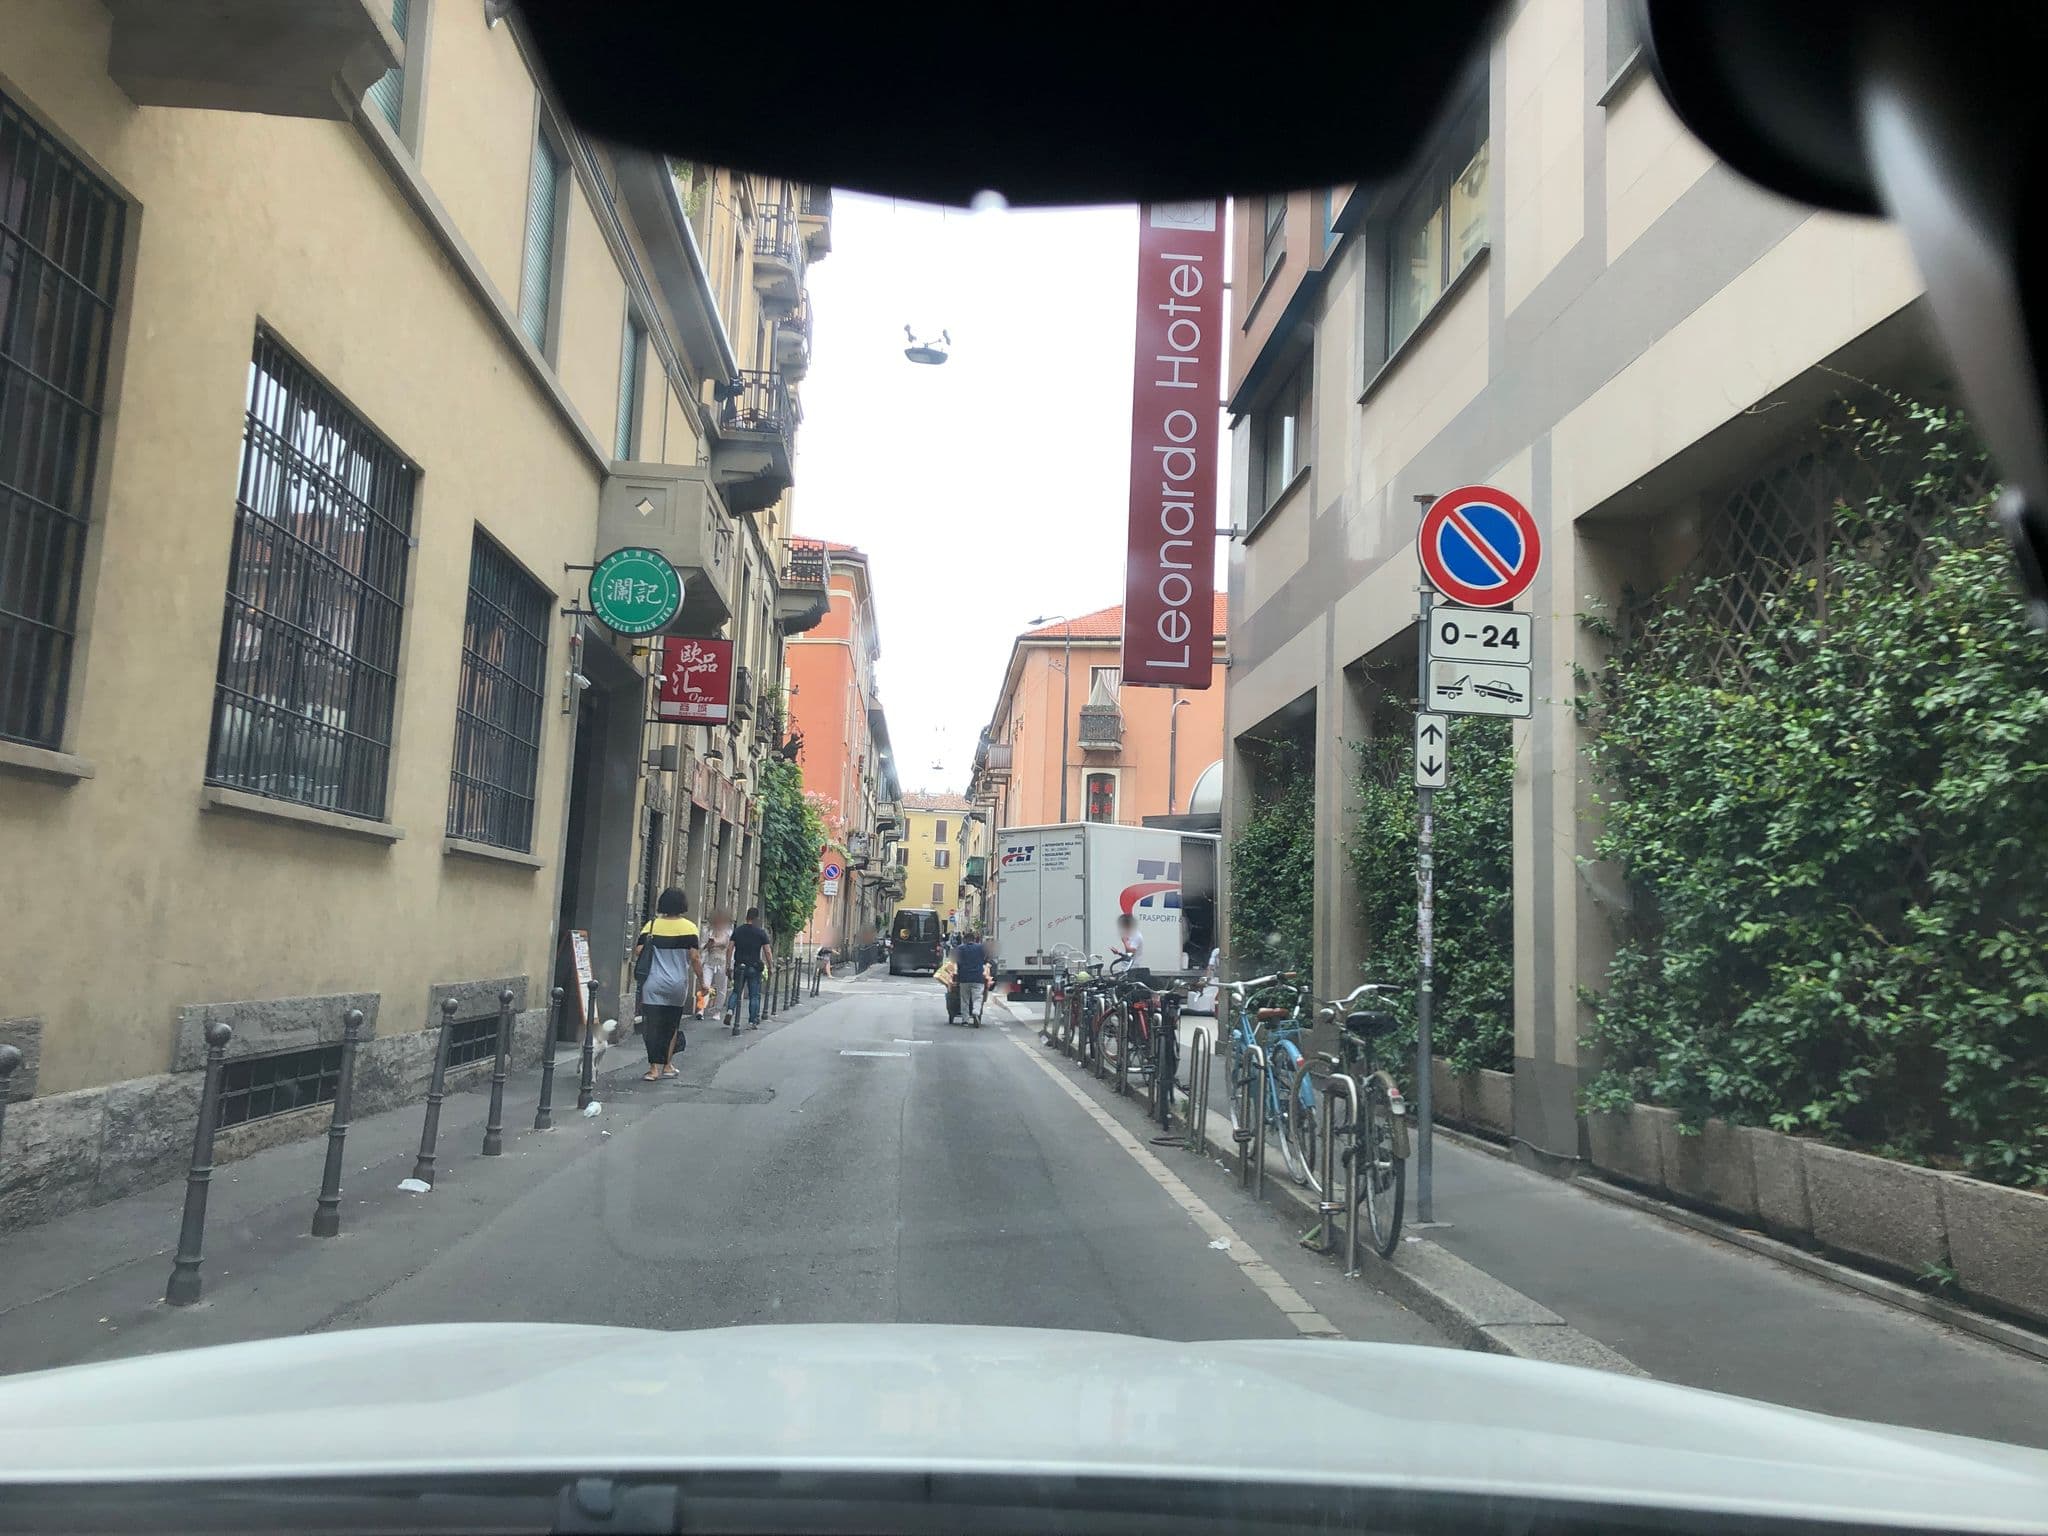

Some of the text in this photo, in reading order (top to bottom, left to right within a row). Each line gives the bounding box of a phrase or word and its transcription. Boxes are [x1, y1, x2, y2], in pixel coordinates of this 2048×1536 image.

[1146, 253, 1204, 668] Leonardo Hotel
[603, 615, 630, 632] STYLE
[635, 621, 658, 632] MILK
[660, 607, 673, 622] TEA
[1441, 621, 1520, 649] 0-24
[1139, 914, 1177, 923] TRASPORTI
